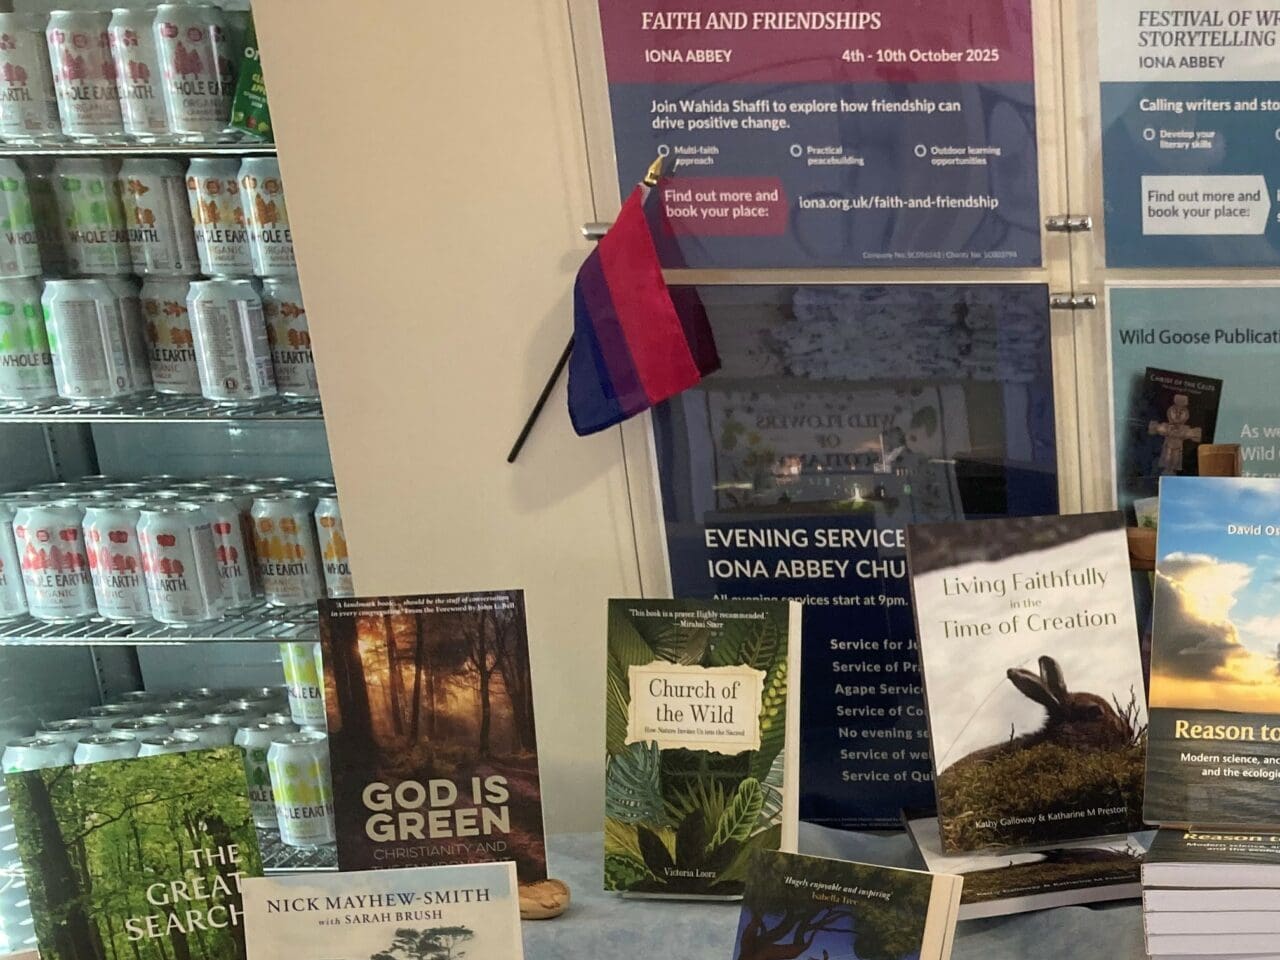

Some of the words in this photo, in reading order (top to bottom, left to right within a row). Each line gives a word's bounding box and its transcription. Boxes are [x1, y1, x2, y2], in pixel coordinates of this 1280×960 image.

[642, 12, 701, 30] FAITH
[705, 13, 747, 29] AND
[752, 12, 881, 30] FRIENDSHIPS
[1138, 10, 1225, 27] FESTIVAL
[1229, 10, 1252, 27] OF
[1138, 30, 1276, 47] STORYTELLING
[652, 117, 684, 129] drive
[688, 117, 738, 131] positive
[741, 117, 790, 131] change.
[807, 146, 842, 155] Practical
[799, 195, 998, 211] iona.org.uk/faith-and-friendship
[1120, 329, 1155, 345] Wild
[1159, 329, 1210, 345] Goose
[1241, 425, 1261, 438] As
[705, 529, 808, 547] EVENING
[1228, 525, 1261, 536] David
[708, 560, 769, 578] IONA
[774, 560, 849, 578] ABBEY
[944, 577, 1006, 596] Living
[1013, 567, 1108, 592] Faithfully
[1010, 599, 1020, 608] in
[1022, 598, 1041, 608] the
[939, 619, 992, 639] Time
[998, 615, 1020, 635] of
[1027, 612, 1117, 633] Creation
[649, 678, 715, 699] Church
[721, 681, 740, 698] of
[656, 705, 684, 724] the
[690, 704, 733, 724] Wild
[1175, 720, 1255, 741] Reason
[1180, 753, 1219, 764] Modern
[1223, 754, 1260, 766] science,
[1202, 767, 1220, 776] and
[1223, 767, 1240, 777] the
[362, 779, 458, 813] GOD
[473, 776, 509, 804] IS
[365, 807, 510, 841] GREEN
[975, 818, 998, 829] Kathy
[1000, 814, 1036, 827] Galloway
[1038, 814, 1045, 822] &
[1048, 809, 1085, 822] Katharine
[1087, 808, 1095, 816] M
[1097, 805, 1127, 815] Preston
[189, 844, 243, 868] THE
[374, 843, 472, 860] CHRISTIANITY
[476, 841, 507, 853] AND
[664, 867, 696, 877] Victoria
[698, 869, 716, 878] Loorz
[147, 872, 246, 905] GREAT
[268, 898, 320, 913] NICK
[326, 888, 490, 910] MAYHEW-SMITH
[126, 904, 245, 941] SEARCH
[318, 917, 341, 926] with
[345, 912, 391, 924] SARAH
[396, 910, 442, 922] BRUSH
